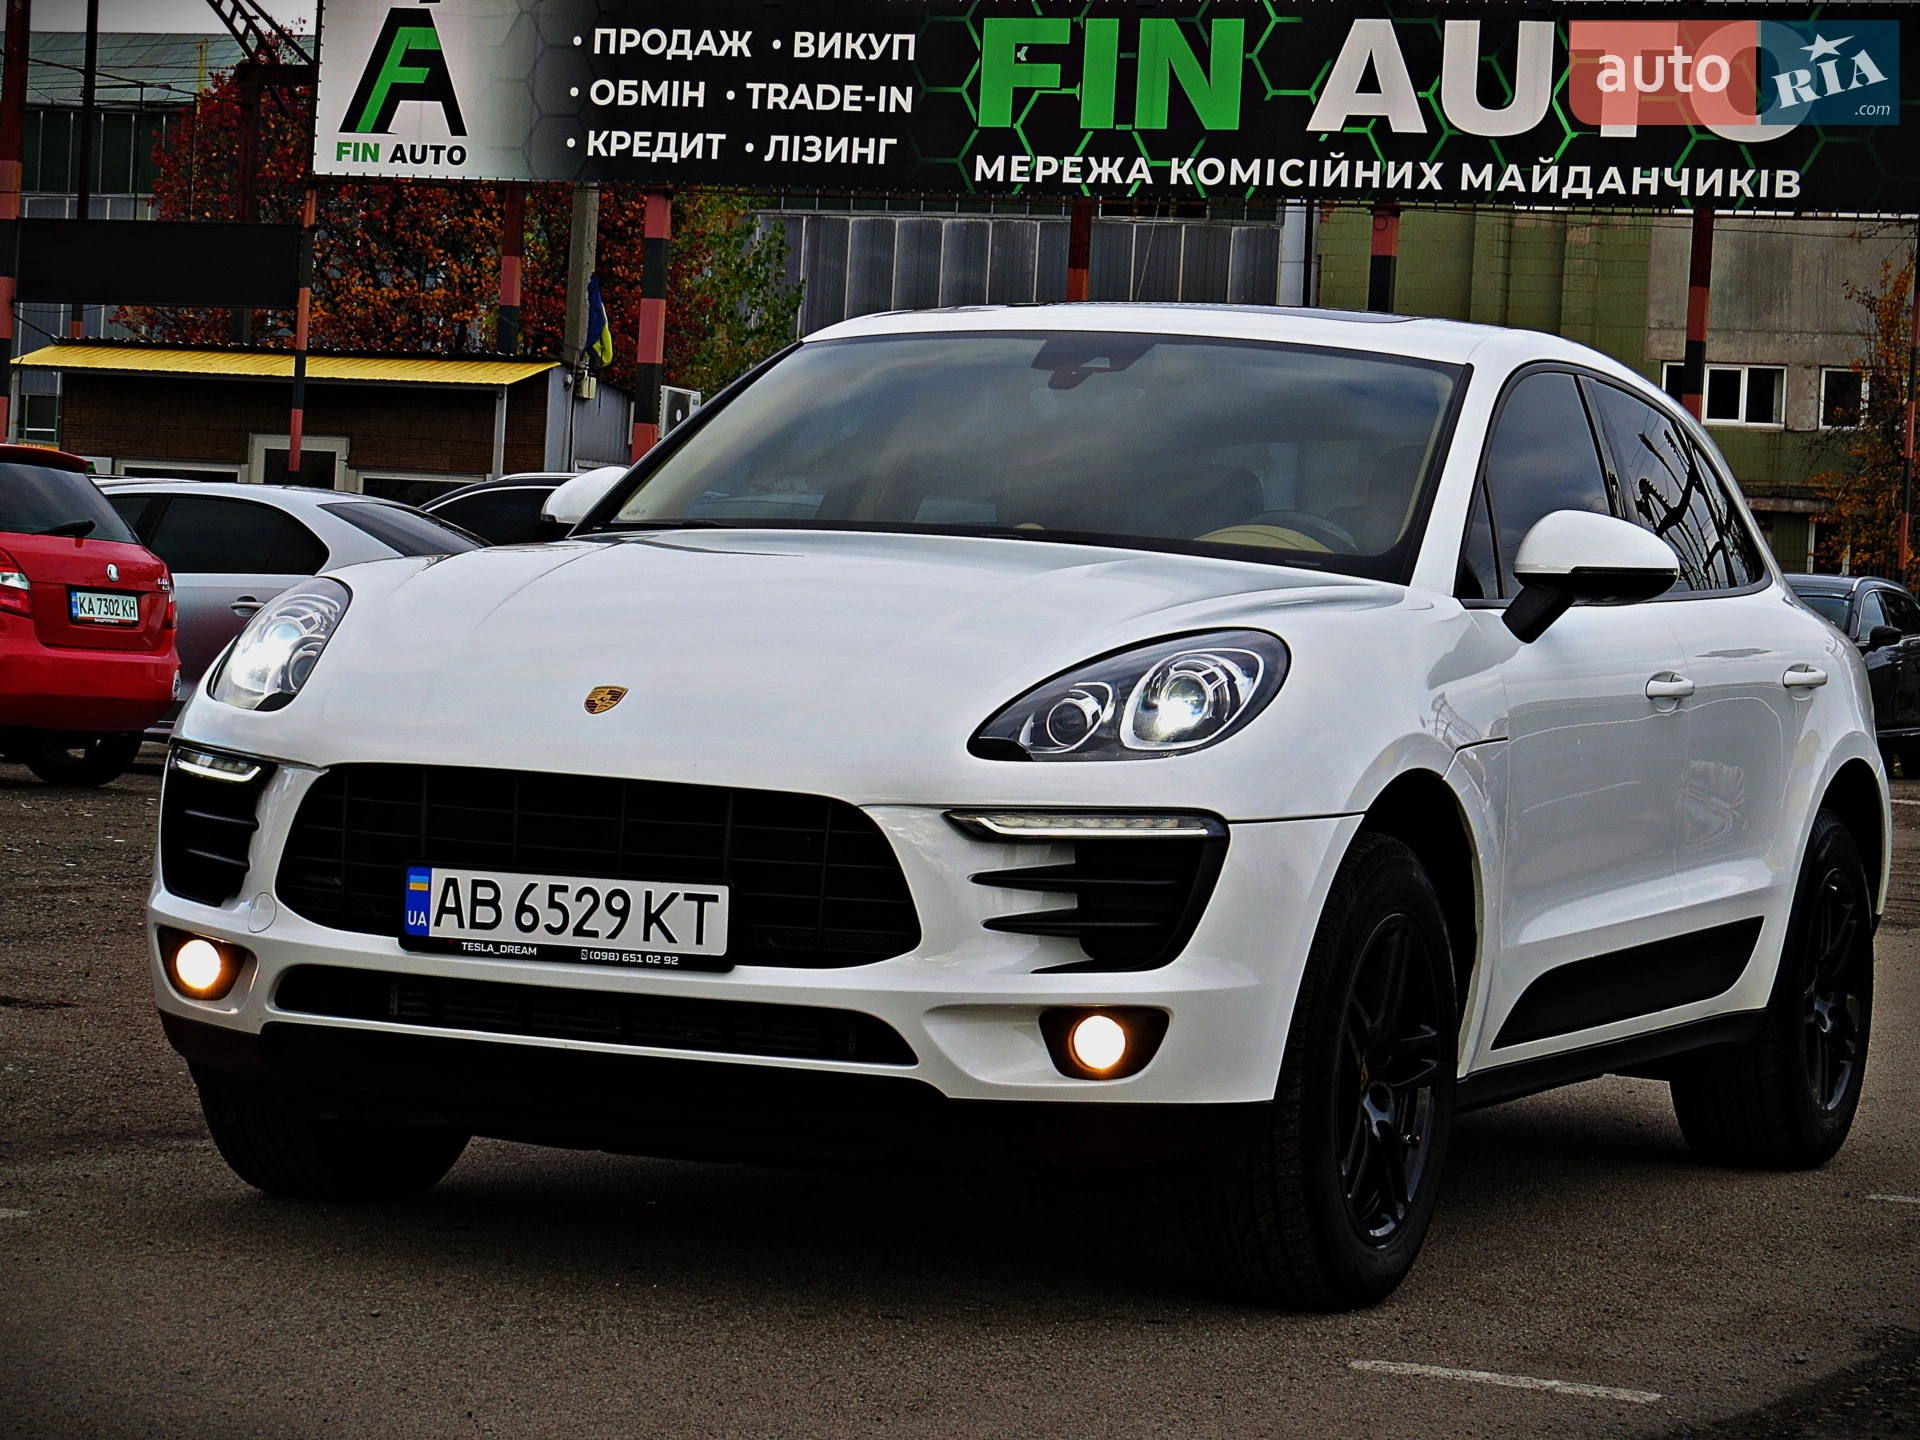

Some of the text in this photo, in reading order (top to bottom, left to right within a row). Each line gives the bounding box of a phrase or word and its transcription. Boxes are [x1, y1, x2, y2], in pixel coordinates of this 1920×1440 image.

[593, 28, 916, 61] ПРОДАЖ ВИКУП
[590, 79, 913, 113] ОБМІН TRADE-IN
[978, 18, 1818, 143] FIN AUTO
[336, 142, 467, 166] FIN AUTO
[587, 130, 898, 165] КРЕДИТ ЛІЗИНГ
[974, 152, 1801, 200] МЕРЕЖА КОМІСІЙНИХ МАЙДАНЧИКІВ
[78, 596, 95, 615] KA
[97, 598, 120, 616] 7302
[122, 600, 137, 618] KH
[407, 910, 428, 927] UA
[433, 876, 720, 946] AB 6529 KT
[461, 941, 537, 956] TESLA_DREAM
[589, 951, 679, 966] (098) 651 02 92
